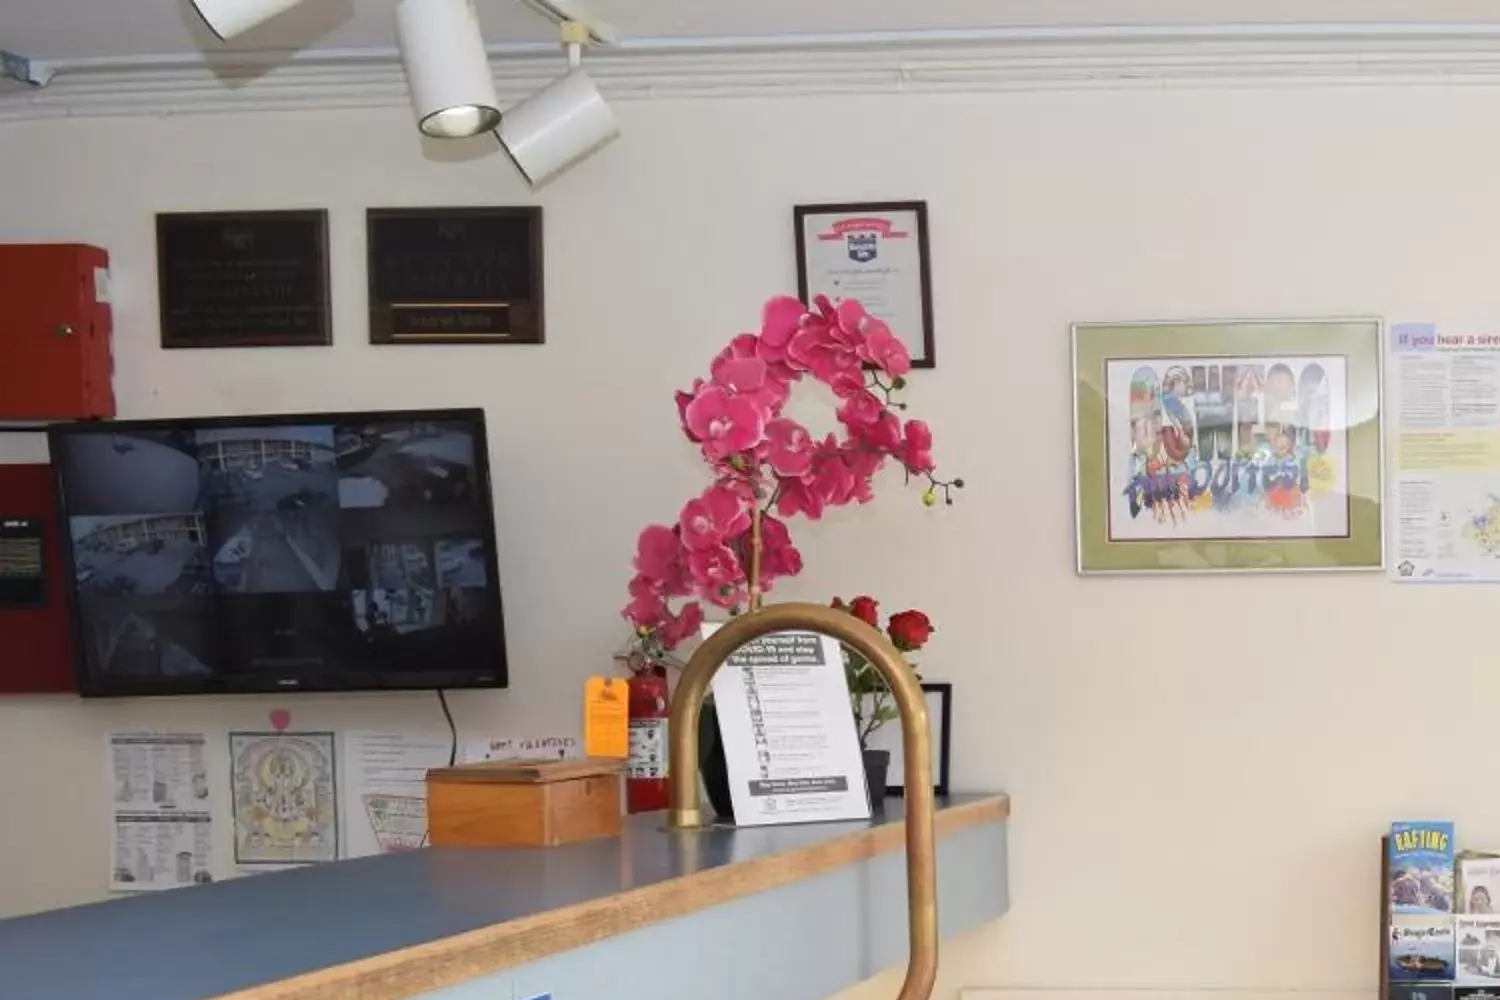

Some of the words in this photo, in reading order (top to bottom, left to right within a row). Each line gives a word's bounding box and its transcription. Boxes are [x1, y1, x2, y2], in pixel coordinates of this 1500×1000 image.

[1399, 334, 1409, 345] If
[1411, 336, 1435, 348] you
[1437, 334, 1464, 345] hear
[1394, 829, 1449, 852] RAFTING
